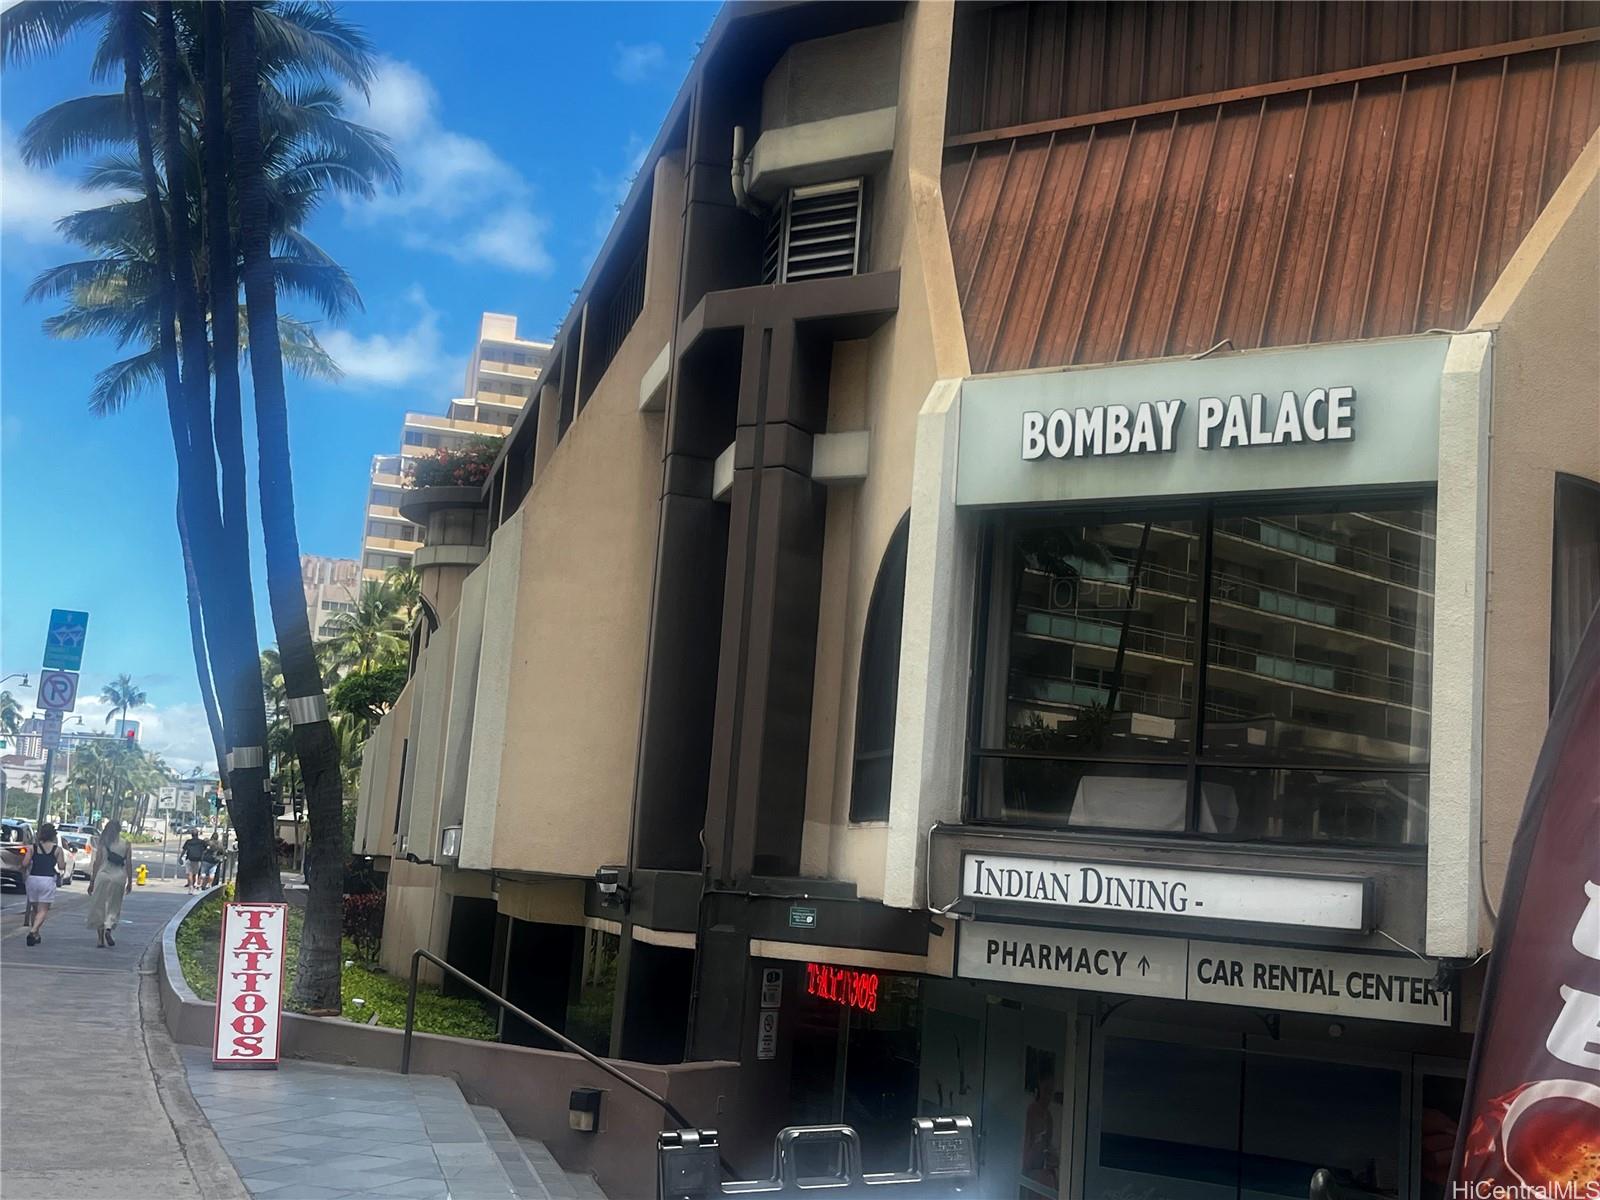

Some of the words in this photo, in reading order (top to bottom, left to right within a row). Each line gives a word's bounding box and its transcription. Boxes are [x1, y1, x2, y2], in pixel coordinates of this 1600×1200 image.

[1021, 399, 1186, 461] BOMBAY
[1198, 386, 1355, 450] PALACE
[973, 859, 1071, 903] INDIAN
[1079, 867, 1188, 912] DINING
[230, 910, 276, 1057] TATTOOS
[986, 939, 1128, 977] PHARMACY
[1196, 958, 1244, 988] CAR
[1253, 963, 1340, 997] RENTAL
[1345, 971, 1439, 1007] CENTER
